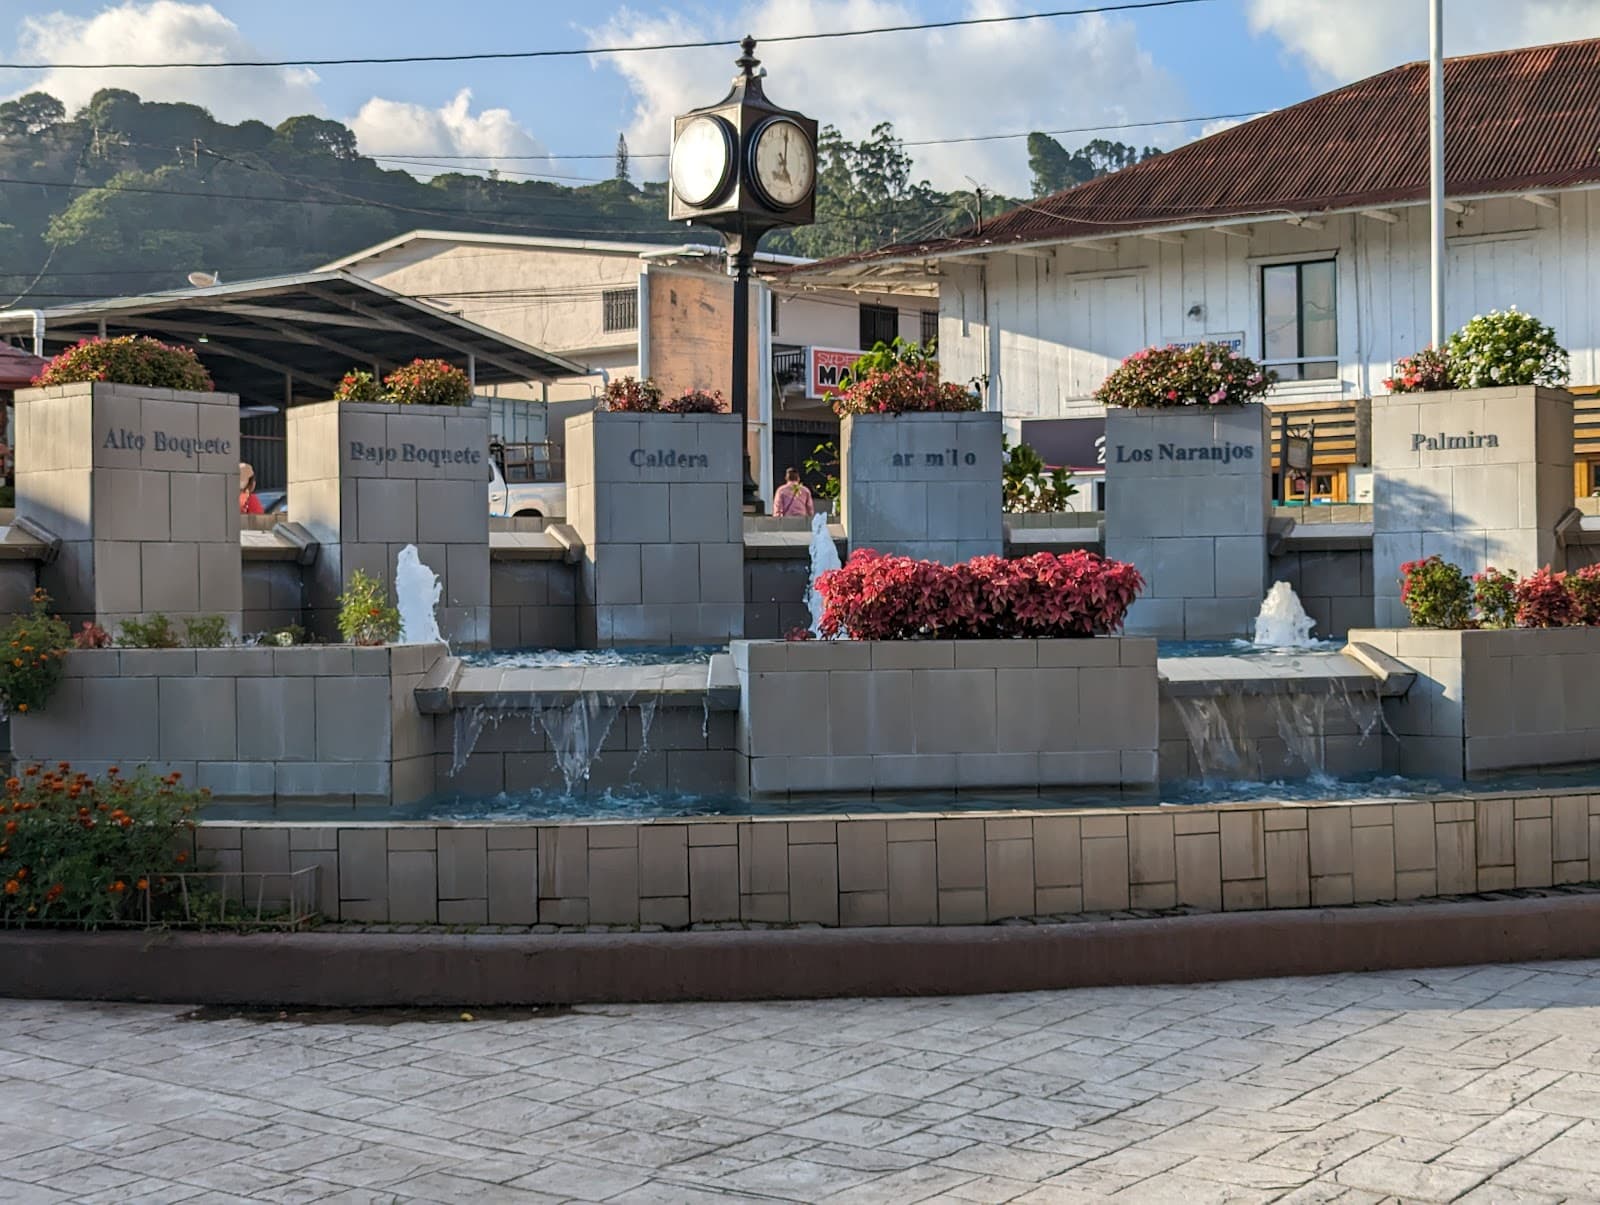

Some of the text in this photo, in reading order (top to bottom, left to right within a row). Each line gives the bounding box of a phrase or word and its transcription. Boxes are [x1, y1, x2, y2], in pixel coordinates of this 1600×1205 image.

[102, 428, 231, 458] Alto Boquete
[1410, 431, 1499, 452] Palmira
[349, 440, 481, 468] Bajo Boquete
[630, 448, 709, 468] Caldera
[1116, 446, 1152, 463] Los
[1158, 442, 1254, 464] Naranjos
